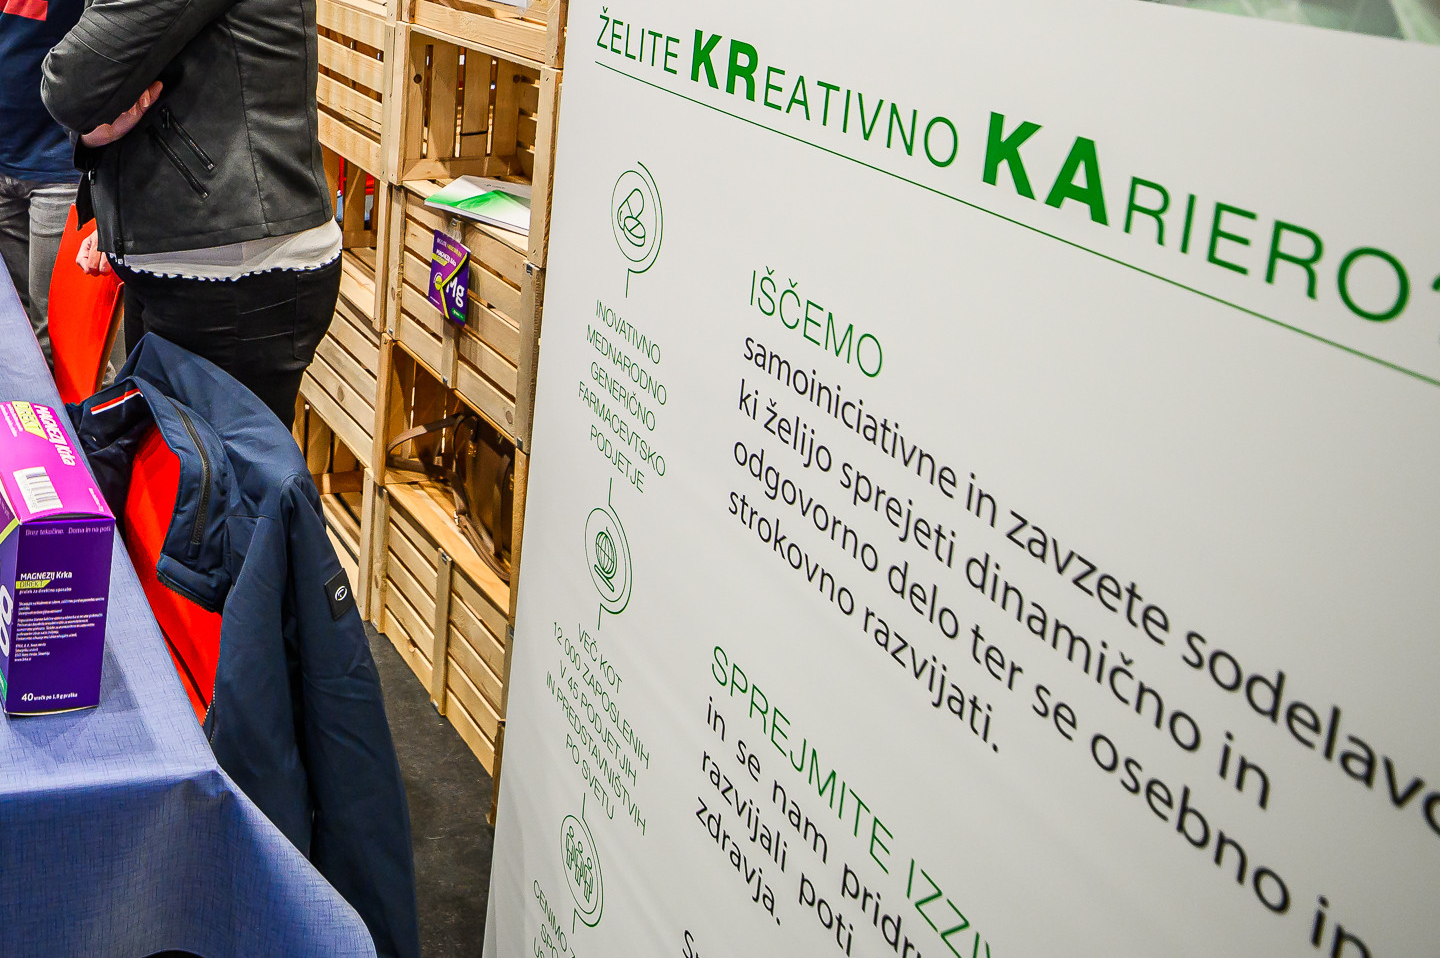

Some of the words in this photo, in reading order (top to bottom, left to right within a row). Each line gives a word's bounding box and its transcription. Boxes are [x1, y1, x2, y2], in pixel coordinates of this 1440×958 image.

[595, 5, 681, 76] ŽELITE
[690, 28, 959, 169] KREATIVNO
[980, 110, 1440, 324] KARIERO
[446, 276, 465, 308] Mg
[595, 299, 661, 365] INOVATIVNO
[749, 266, 884, 379] IŠČEMO
[586, 324, 667, 406] MEDNARODNO
[590, 361, 656, 432] GENERIČNO
[578, 380, 666, 477] FARMACEVTSKO
[590, 424, 645, 494] PODJETJE
[743, 336, 958, 500] samoiniciativne
[965, 471, 998, 529] in
[1004, 508, 1171, 648] zavzete
[56, 571, 73, 580] Krka
[728, 491, 855, 617] strokovno
[862, 605, 999, 754] razvijati.
[738, 377, 759, 422] ki
[763, 397, 833, 473] želijo
[839, 461, 958, 570] sprejeti
[964, 551, 1203, 754] dinamično
[1217, 730, 1271, 812] in
[21, 692, 34, 702] 40
[553, 621, 563, 647] 12
[564, 637, 581, 671] 000
[581, 662, 650, 771] ZAPOSLENIH
[578, 622, 598, 662] VEČ
[599, 653, 623, 694] KOT
[733, 441, 880, 574] odgovorno
[886, 559, 961, 641] delo
[969, 622, 1025, 692] ter
[1031, 682, 1078, 743] se
[1089, 732, 1292, 917] osebno
[546, 670, 556, 696] IN
[556, 686, 647, 837] PREDSTAVNIŠTVIH
[560, 659, 567, 680] V
[567, 675, 579, 700] 45
[580, 691, 637, 789] PODJETJIH
[566, 732, 580, 765] PO
[581, 759, 615, 821] SVETU
[706, 695, 726, 744] in
[735, 738, 761, 784] se
[771, 778, 828, 866] nam
[711, 645, 894, 876] SPREJMITE
[695, 795, 781, 927] zdravja.
[701, 749, 789, 875] razvijali
[797, 870, 855, 958] poti
[533, 879, 568, 953] CENIMO
